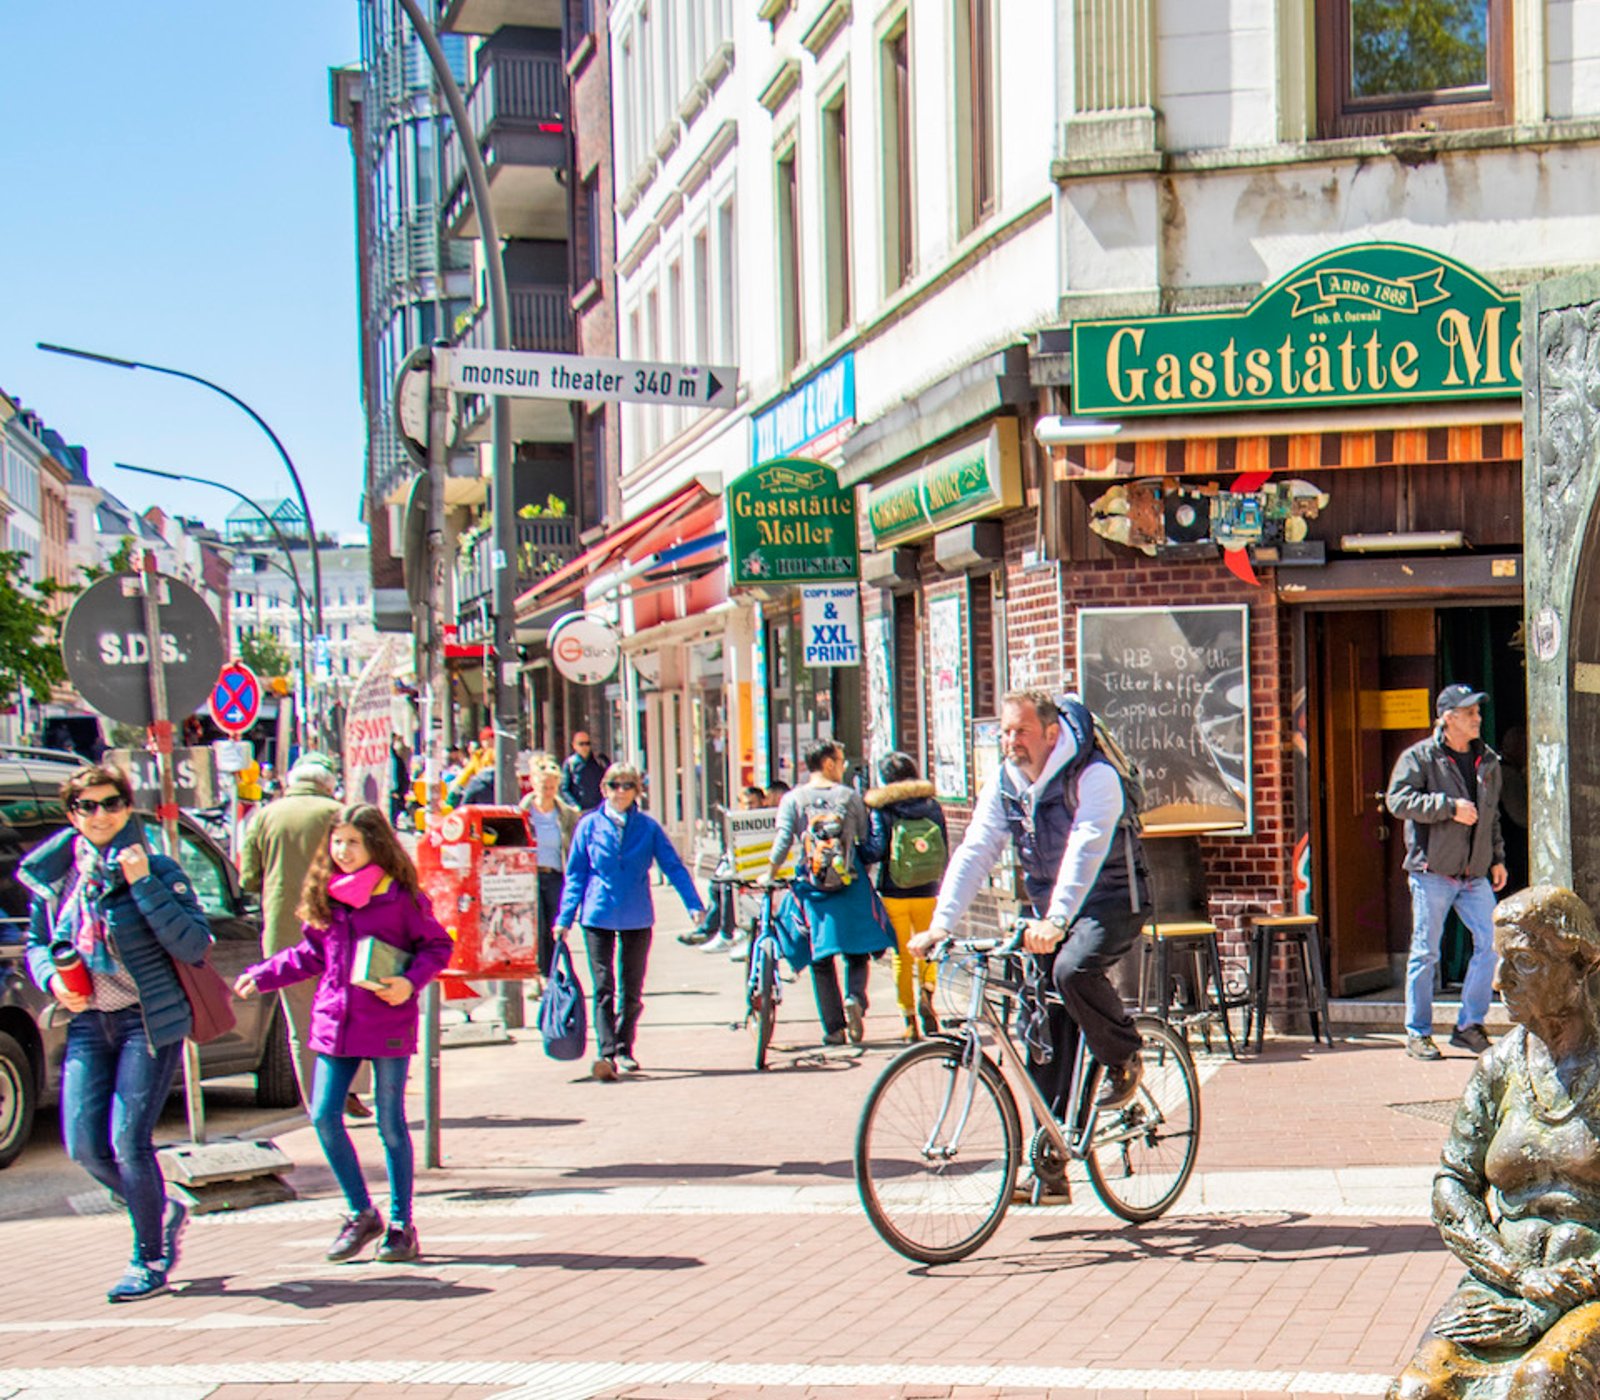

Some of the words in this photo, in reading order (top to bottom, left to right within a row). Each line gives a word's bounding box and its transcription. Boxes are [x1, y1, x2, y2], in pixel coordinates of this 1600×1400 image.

[1329, 276, 1370, 295] Anno
[1374, 284, 1407, 306] 1868
[1105, 325, 1420, 403] Gaststätte
[462, 364, 540, 387] monsun
[551, 365, 624, 393] theater
[634, 369, 672, 395] 340
[678, 377, 696, 397] m
[735, 491, 852, 518] Gaststätte
[756, 519, 834, 546] Möller
[775, 556, 853, 575] HOLSTEN
[803, 588, 828, 598] COPY
[830, 588, 856, 598] SHOP
[823, 602, 839, 619] &
[811, 624, 853, 645] XXL
[99, 633, 187, 664] S.DS.
[806, 644, 858, 662] PRINT
[1104, 671, 1215, 700] Filterkaffee
